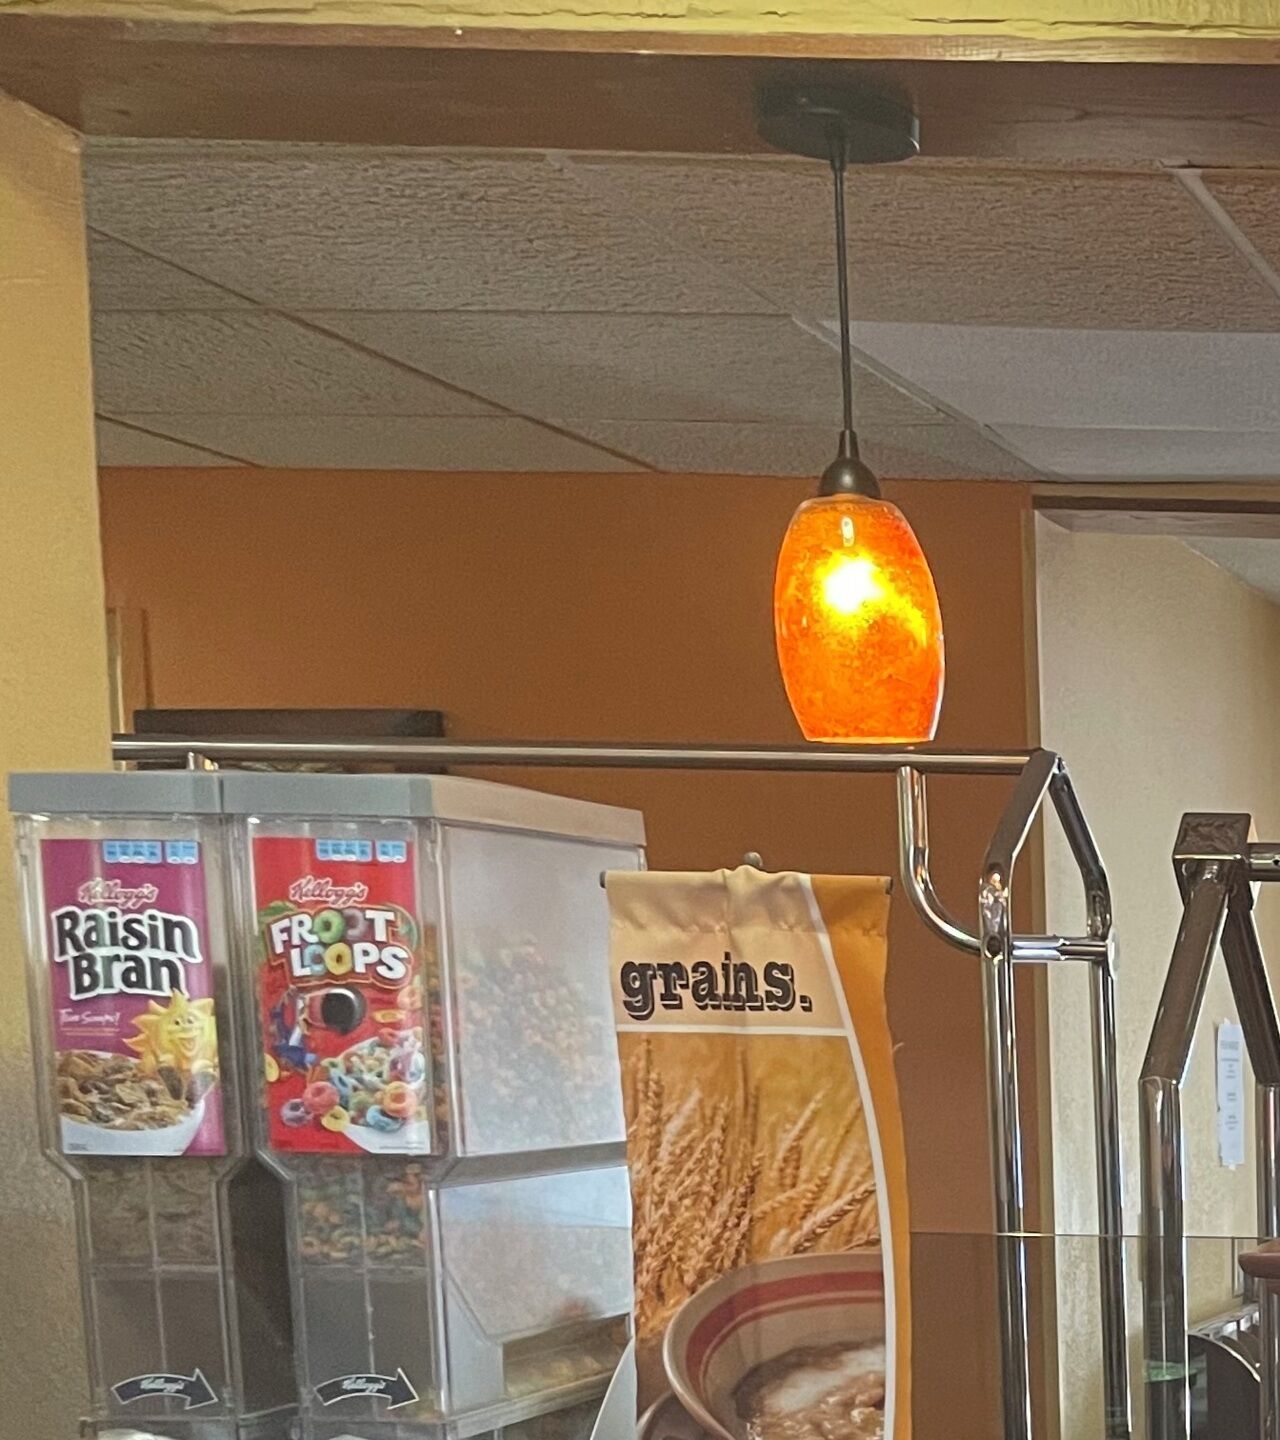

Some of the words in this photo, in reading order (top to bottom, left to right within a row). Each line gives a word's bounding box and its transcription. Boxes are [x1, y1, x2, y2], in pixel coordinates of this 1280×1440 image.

[79, 878, 158, 908] Kellogg's
[290, 875, 368, 907] Kellogg's
[54, 908, 199, 961] Raisin
[271, 909, 395, 953] FROOT
[71, 952, 188, 997] Bran
[291, 943, 408, 979] LOOPS
[620, 951, 812, 1020] grains.
[342, 1376, 386, 1394] Kellogg's
